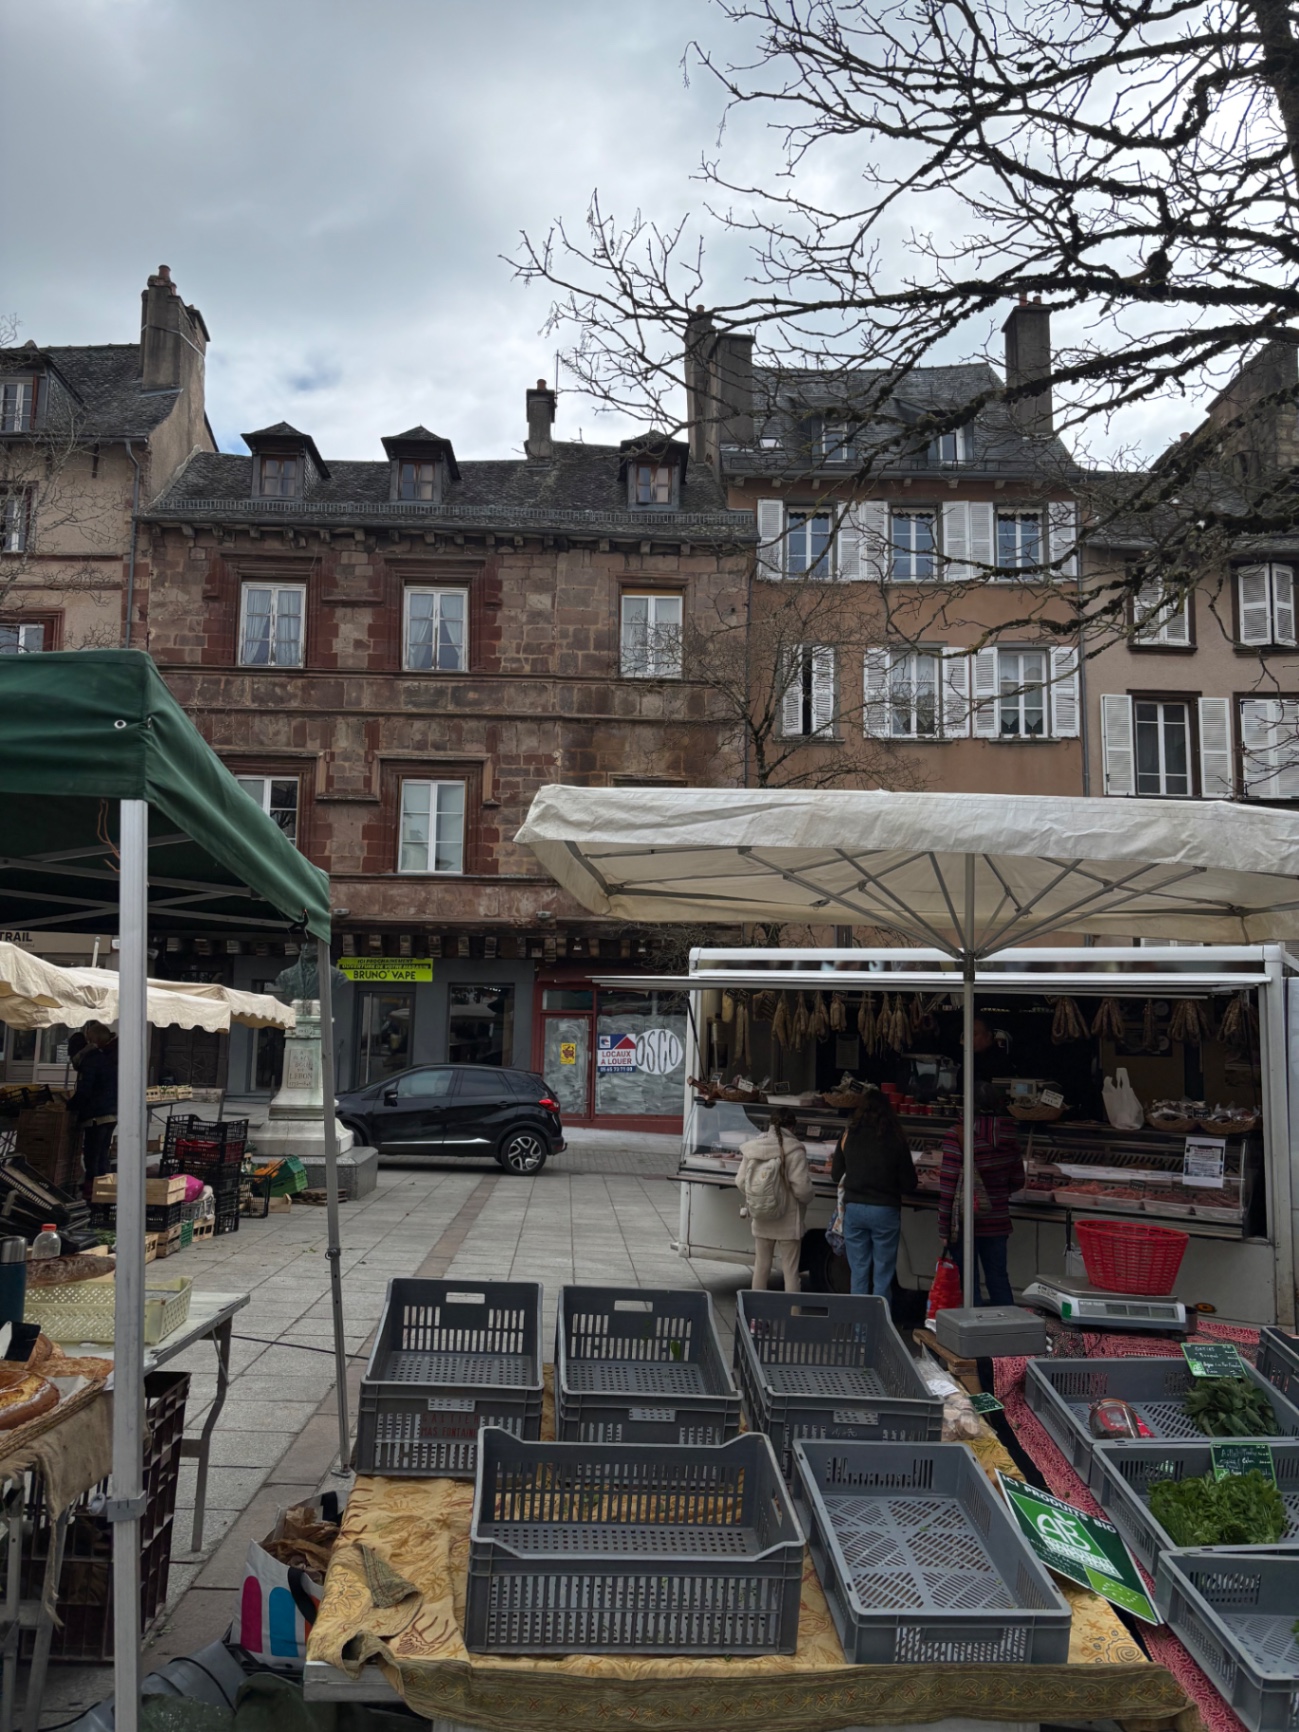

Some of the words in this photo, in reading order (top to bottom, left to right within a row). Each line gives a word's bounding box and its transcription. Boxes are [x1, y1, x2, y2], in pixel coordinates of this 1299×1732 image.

[392, 970, 416, 980] VAPE
[601, 1050, 631, 1058] LOCAUX
[1002, 1475, 1019, 1488] ICI
[1024, 1486, 1089, 1522] PRODUITS
[1093, 1518, 1117, 1534] BIO
